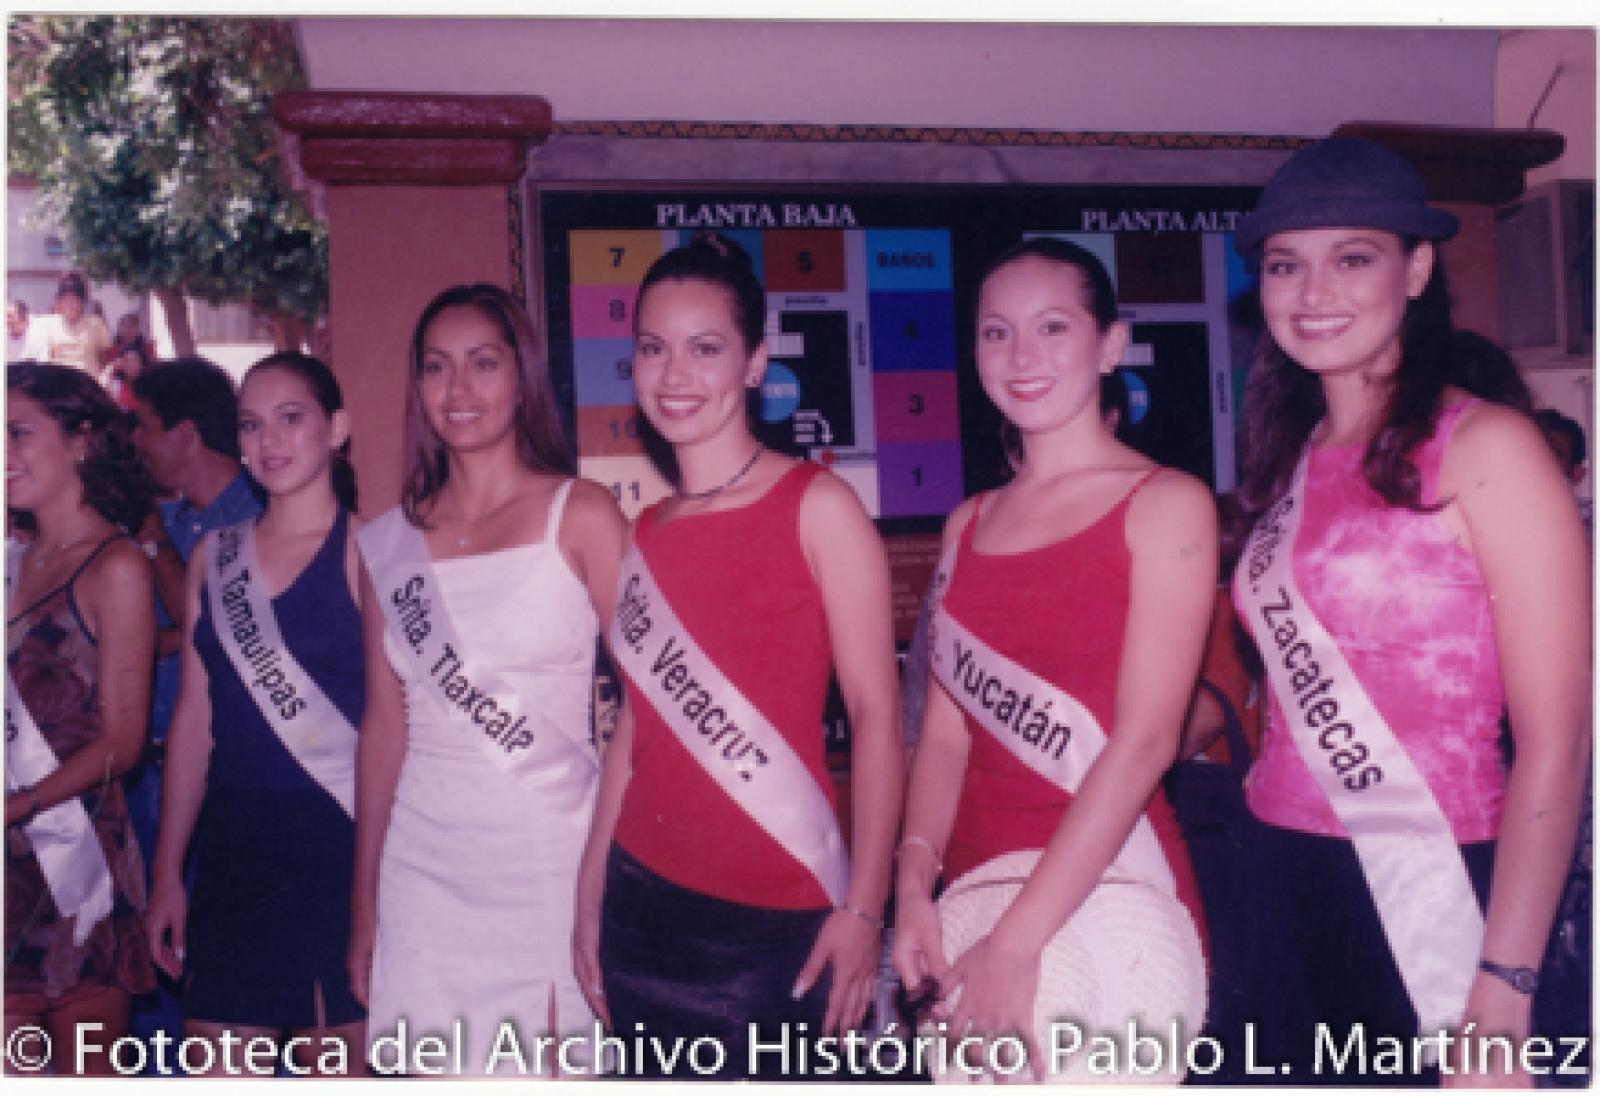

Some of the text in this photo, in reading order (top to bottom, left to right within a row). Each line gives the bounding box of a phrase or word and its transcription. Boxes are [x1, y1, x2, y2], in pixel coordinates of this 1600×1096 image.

[656, 203, 857, 227] PLANTA BAJA
[1080, 209, 1251, 231] PLANTA ALT
[609, 246, 626, 268] 7
[609, 301, 627, 322] 8
[615, 360, 634, 381] 9
[909, 395, 926, 416] 3
[911, 465, 924, 487] 1
[391, 573, 433, 656] Srita.
[221, 568, 308, 721] Tamaulipas
[951, 638, 1073, 761] Yucatán
[1259, 585, 1385, 794] Zacatecas
